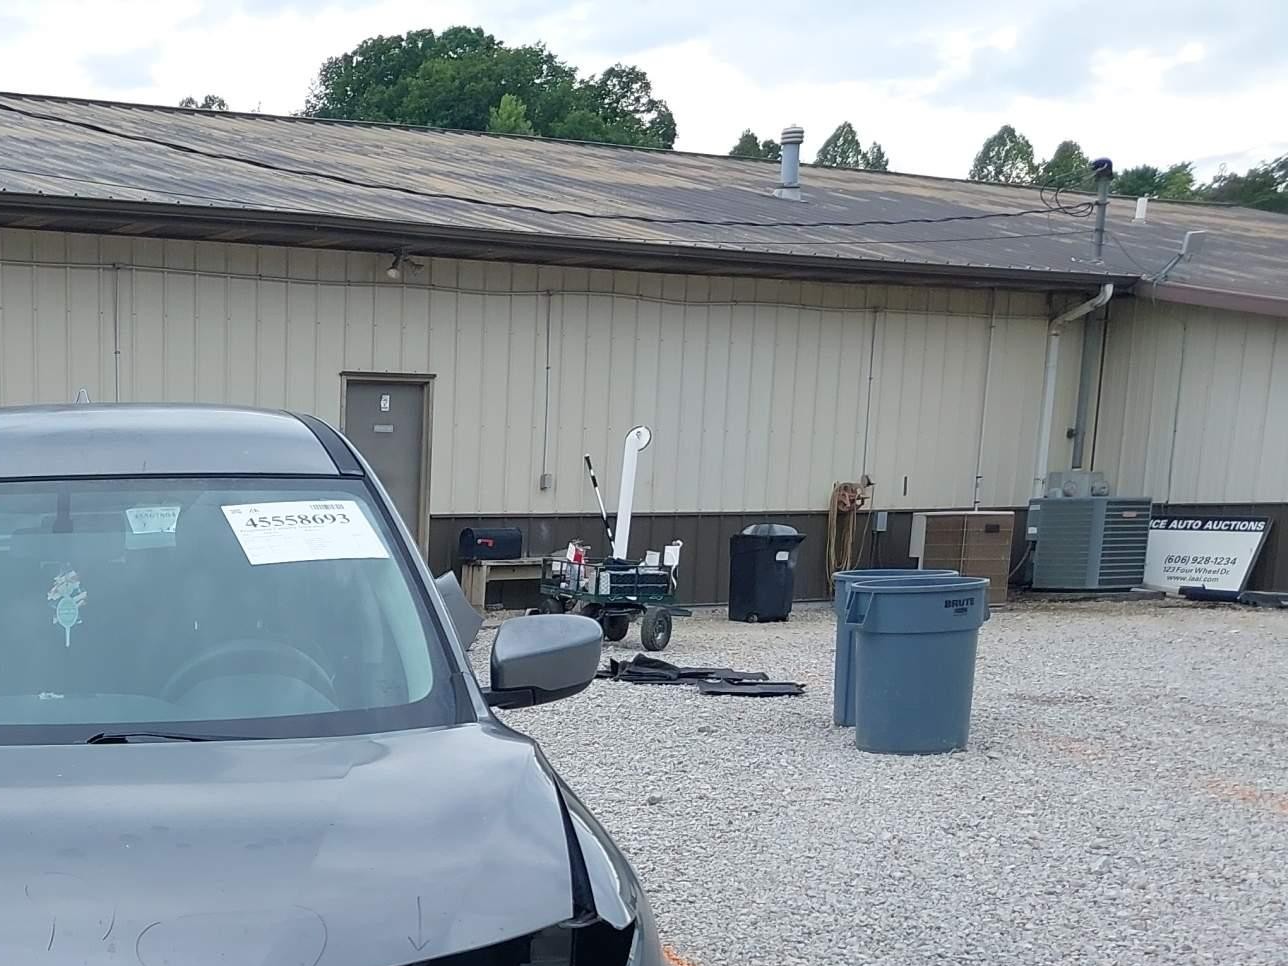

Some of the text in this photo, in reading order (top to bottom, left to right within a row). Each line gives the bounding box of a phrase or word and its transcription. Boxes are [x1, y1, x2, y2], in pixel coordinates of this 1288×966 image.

[245, 513, 351, 528] 45558693
[1168, 519, 1201, 529] AUTO
[1203, 520, 1266, 530] AUCTIONS
[1164, 554, 1238, 566] (606) 928-1234
[1175, 566, 1194, 574] Four
[1194, 567, 1220, 575] Wheel
[944, 597, 975, 608] BRUTE
